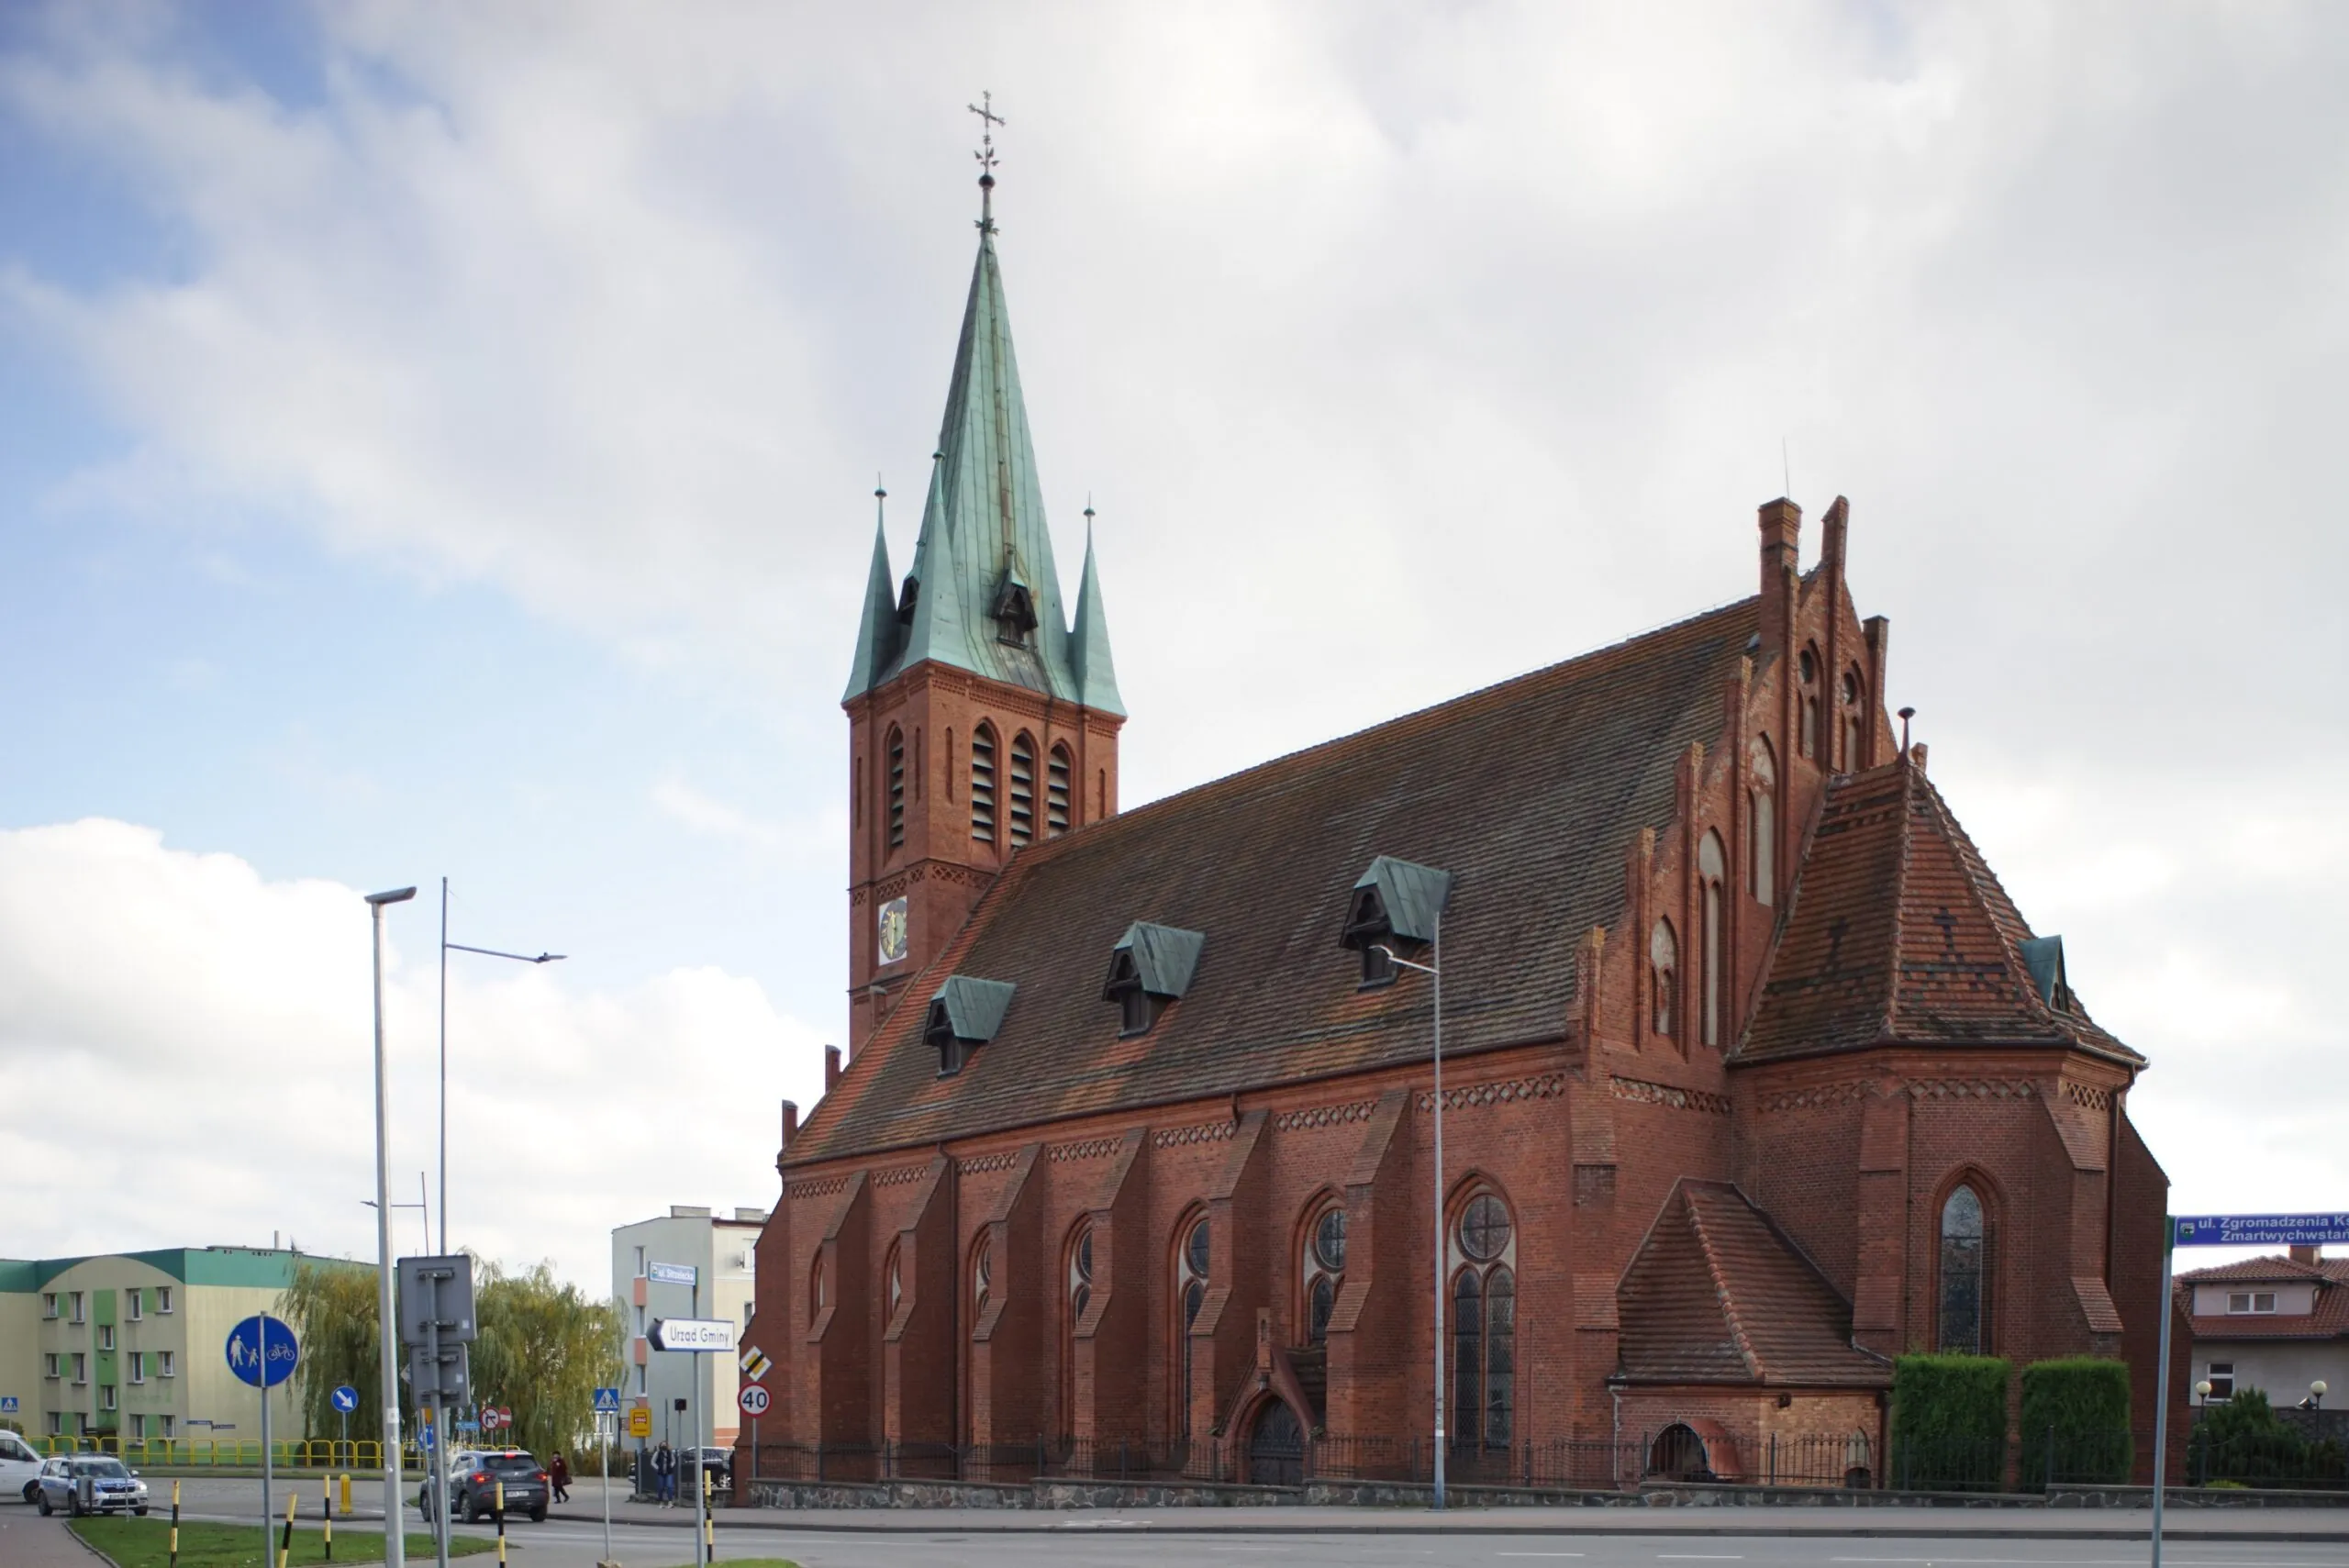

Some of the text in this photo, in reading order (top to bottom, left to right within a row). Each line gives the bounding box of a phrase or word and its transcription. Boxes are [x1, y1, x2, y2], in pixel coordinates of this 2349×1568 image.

[2199, 1217, 2216, 1229] ul.
[2220, 1215, 2329, 1230] Zgromadzenia
[670, 1326, 729, 1347] Urząd Gminy
[742, 1392, 767, 1408] 40
